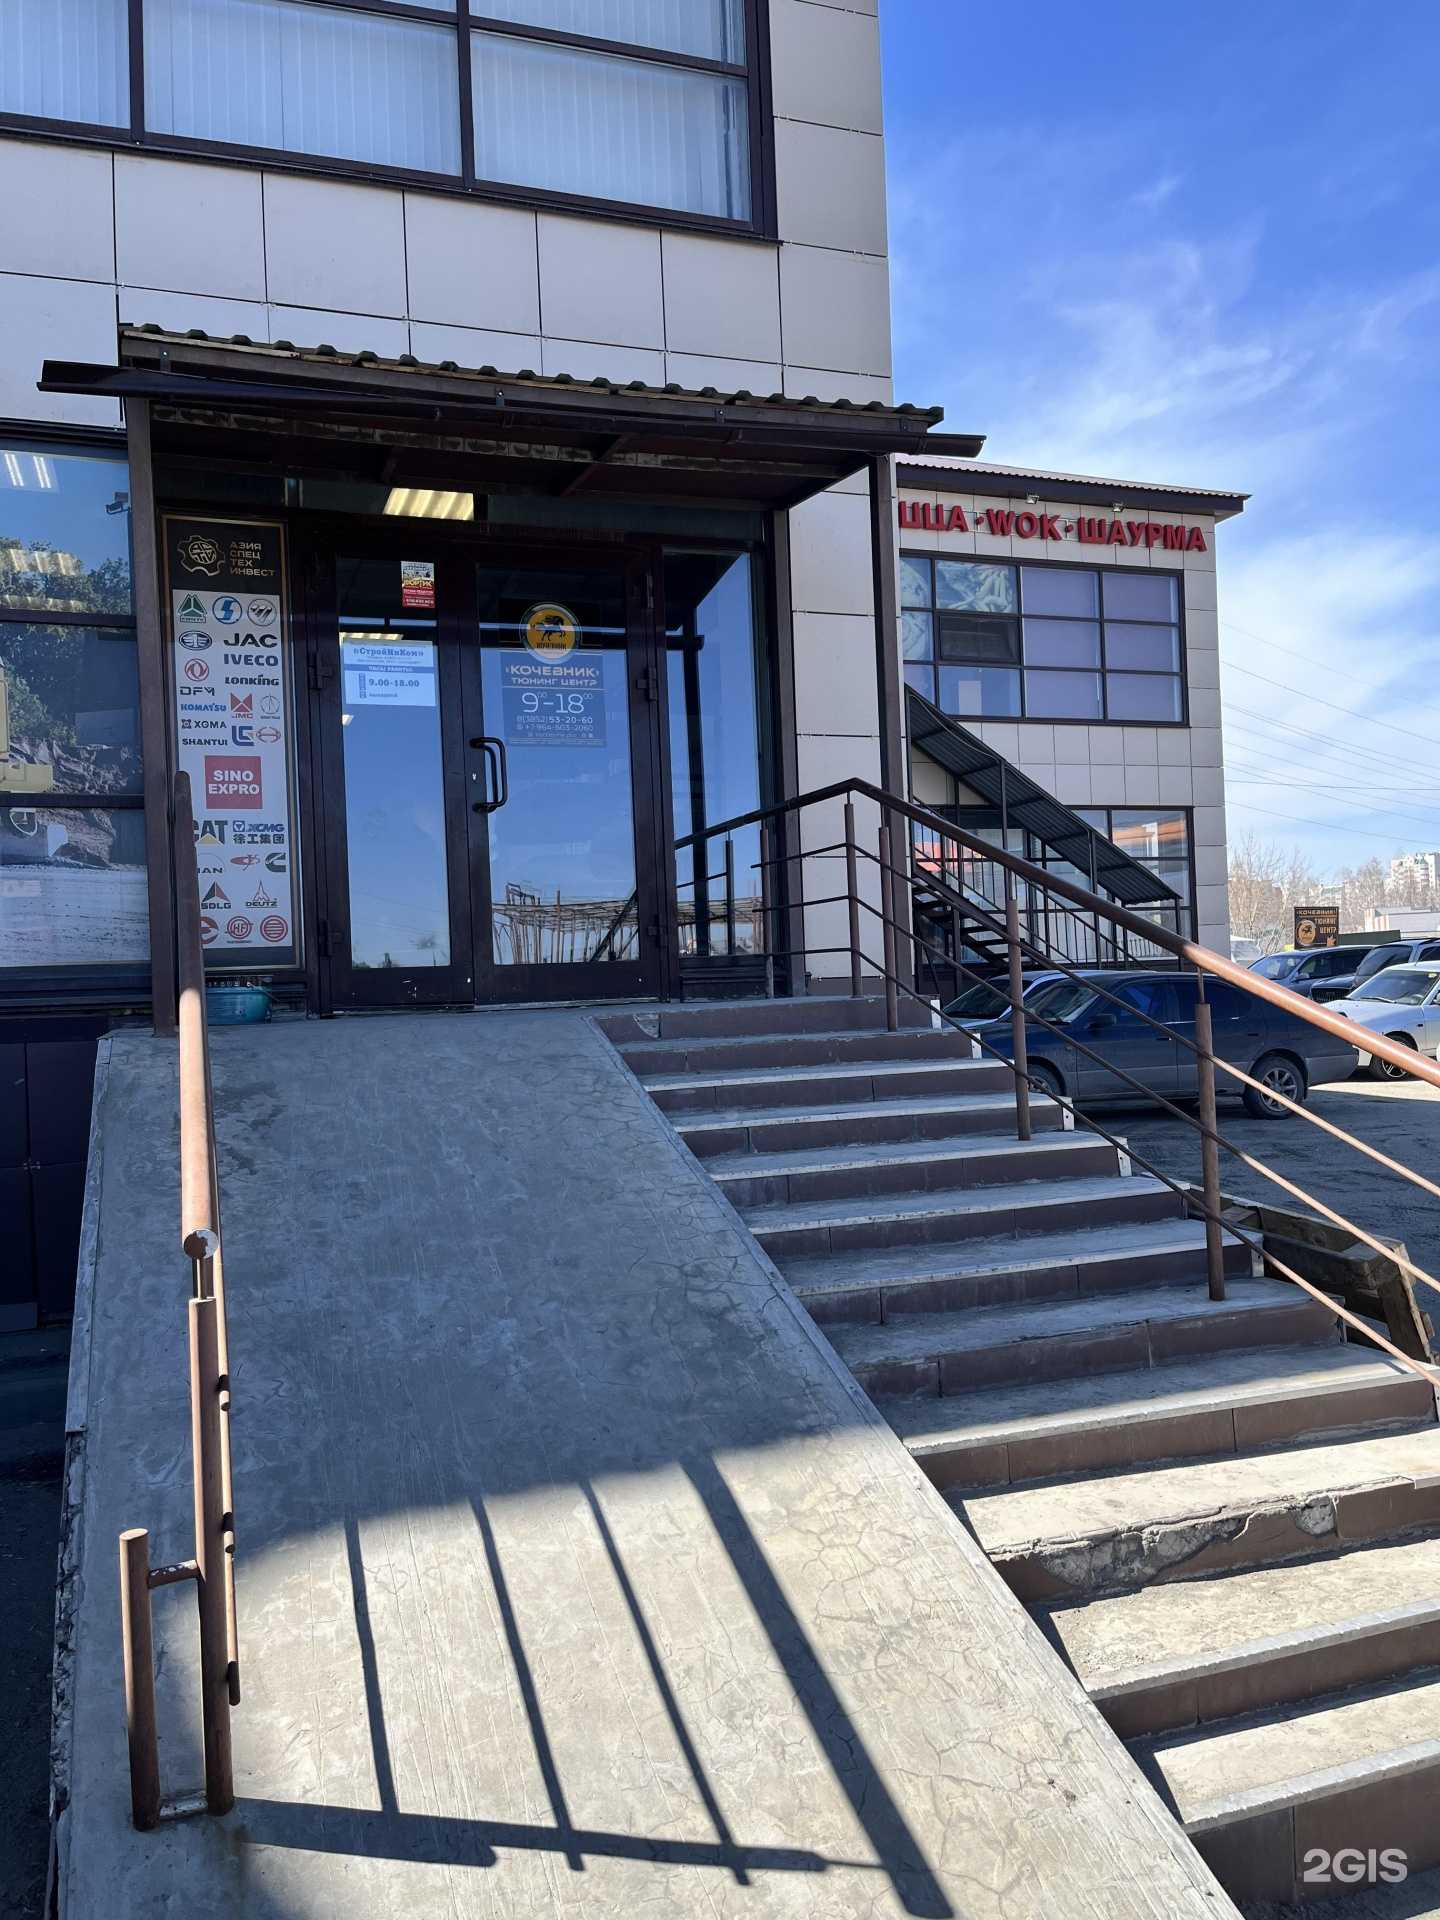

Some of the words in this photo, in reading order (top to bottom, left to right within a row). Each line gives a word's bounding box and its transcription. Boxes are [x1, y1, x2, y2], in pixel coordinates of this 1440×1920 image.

[986, 507, 1063, 541] WOK
[1077, 517, 1208, 552] ШАУРМА
[230, 541, 262, 550] АЗИЯ
[230, 550, 261, 560] СПЕЦ
[231, 559, 254, 567] ТЕХ
[230, 567, 275, 577] ИНВЕСТ
[223, 633, 278, 648] JAC
[223, 654, 279, 667] IVECO
[511, 677, 558, 686] ТЮНИНГ
[560, 679, 598, 687] ЦЕНТР
[180, 702, 227, 712] KOMATSU
[549, 716, 593, 725] 53-20-60
[182, 738, 228, 746] SHANTUI
[213, 769, 254, 782] SINO
[208, 783, 260, 795] EXPRO
[246, 823, 285, 832] XCMG
[201, 902, 231, 910] SDLG
